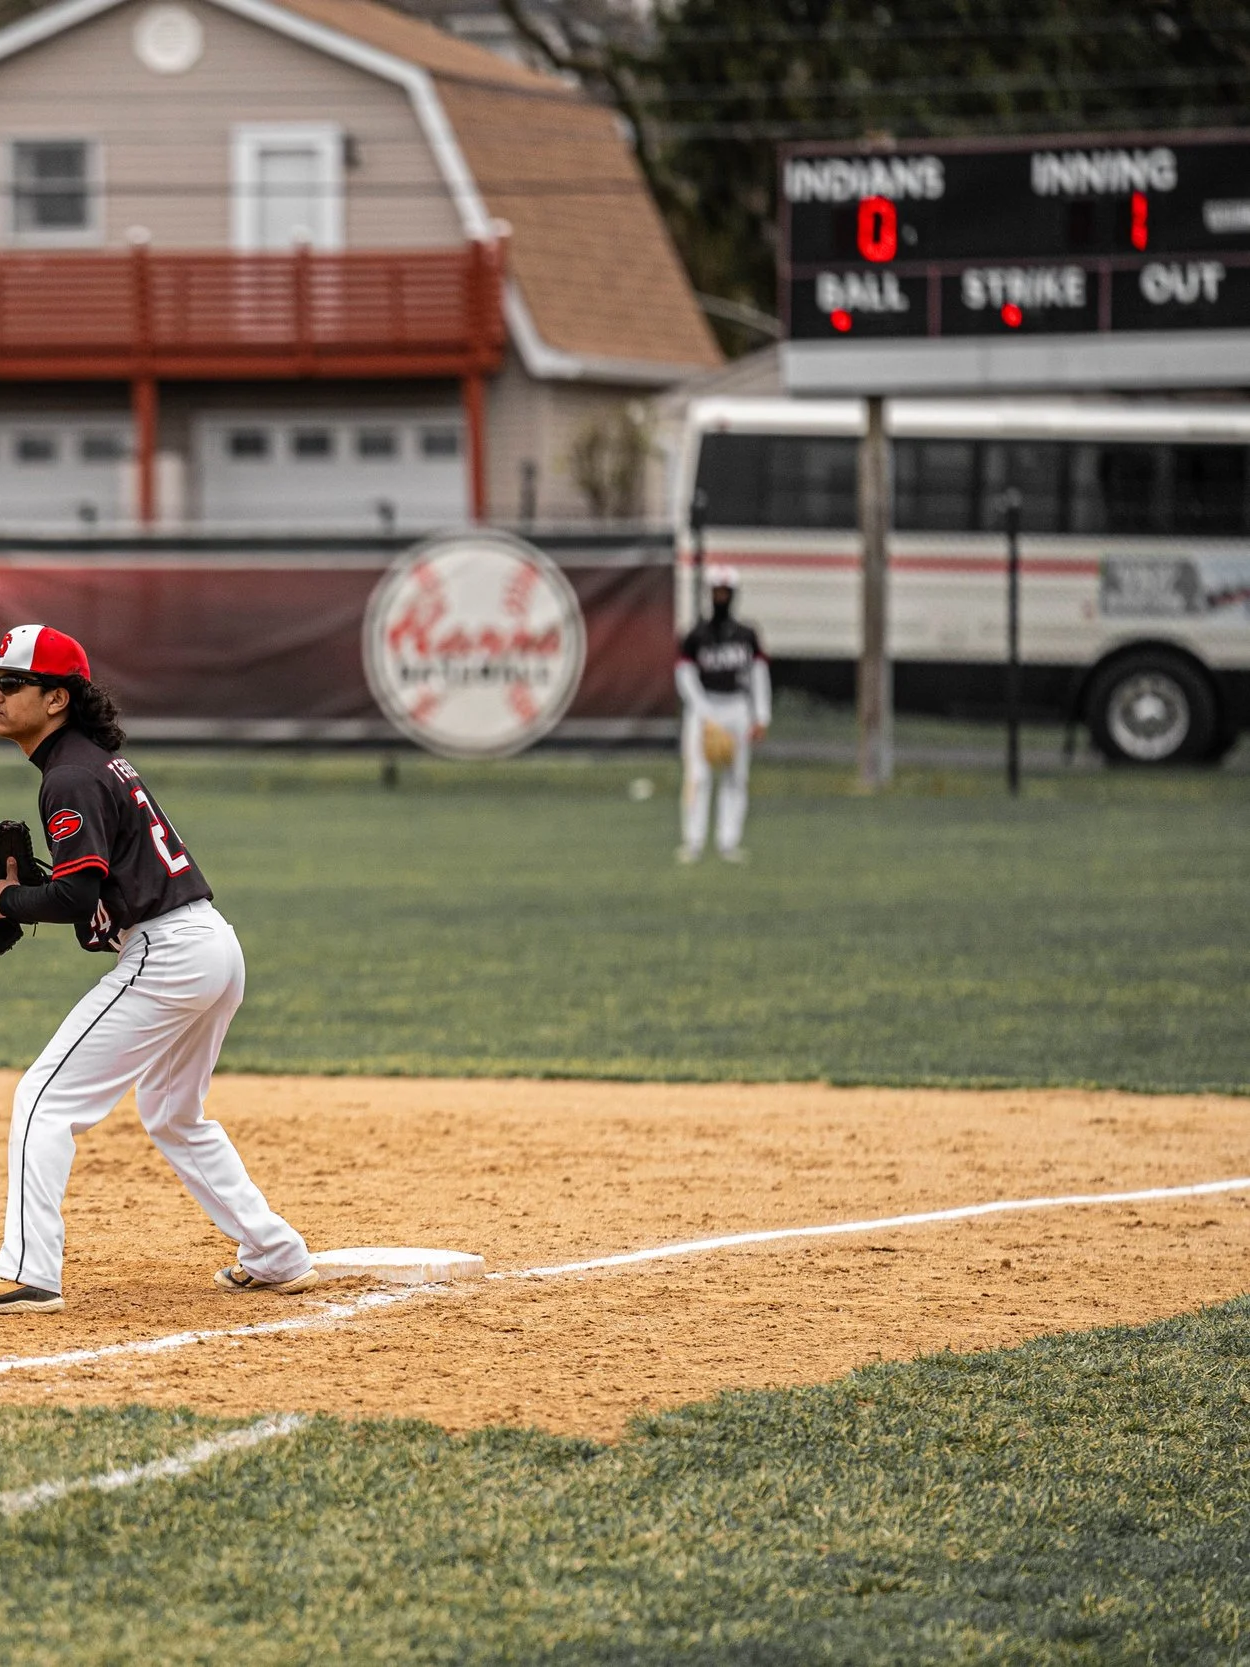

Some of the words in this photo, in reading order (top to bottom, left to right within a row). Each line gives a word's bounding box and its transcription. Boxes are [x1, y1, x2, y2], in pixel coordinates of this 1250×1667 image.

[784, 155, 946, 203] INDIANS
[1030, 147, 1178, 196] INNING
[857, 195, 898, 263] 0
[1130, 191, 1149, 251] 1
[815, 270, 910, 313] BALL
[961, 265, 1087, 310] STRIKE
[1139, 261, 1226, 304] OUT
[130, 786, 191, 877] 2
